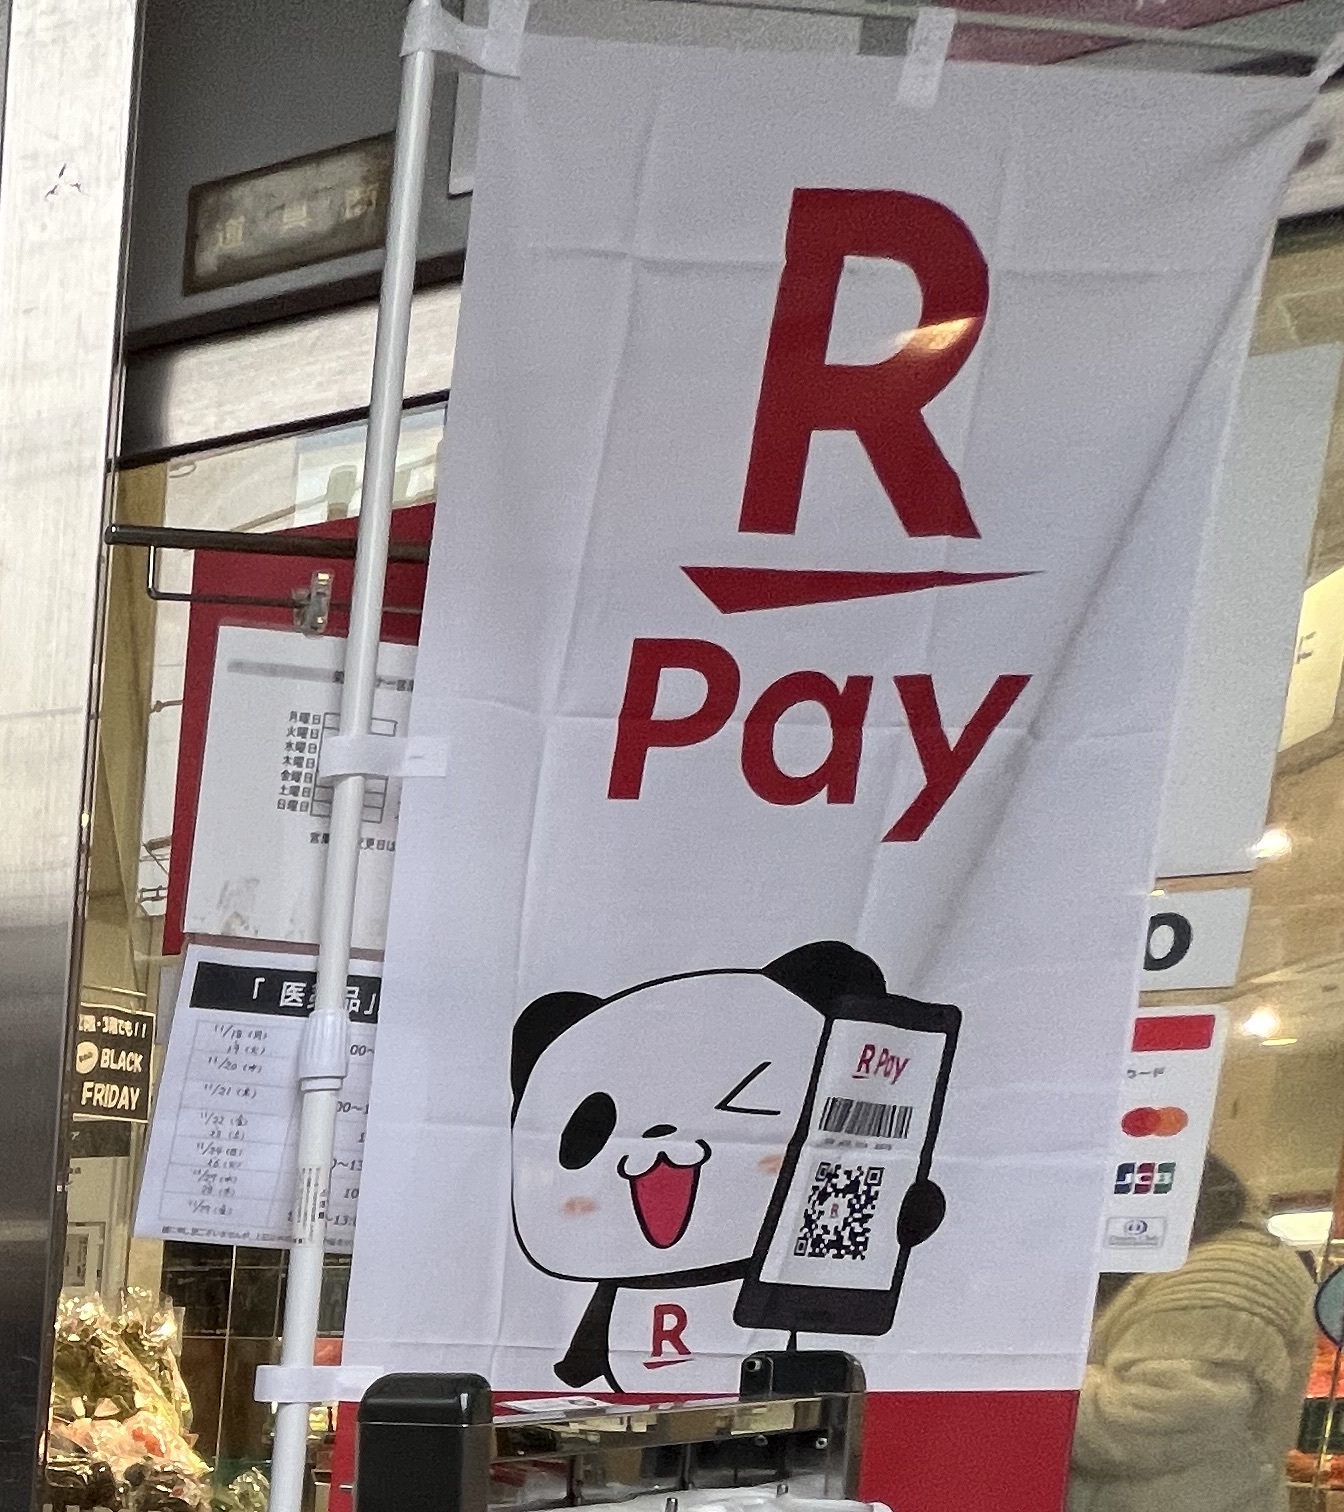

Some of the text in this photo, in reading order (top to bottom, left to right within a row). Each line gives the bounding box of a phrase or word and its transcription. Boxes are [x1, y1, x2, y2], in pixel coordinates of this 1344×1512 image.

[737, 187, 989, 539] R
[608, 638, 1033, 843] Pay
[100, 1048, 144, 1073] BLACK
[80, 1081, 141, 1111] FRIDAY
[650, 1303, 692, 1357] R
